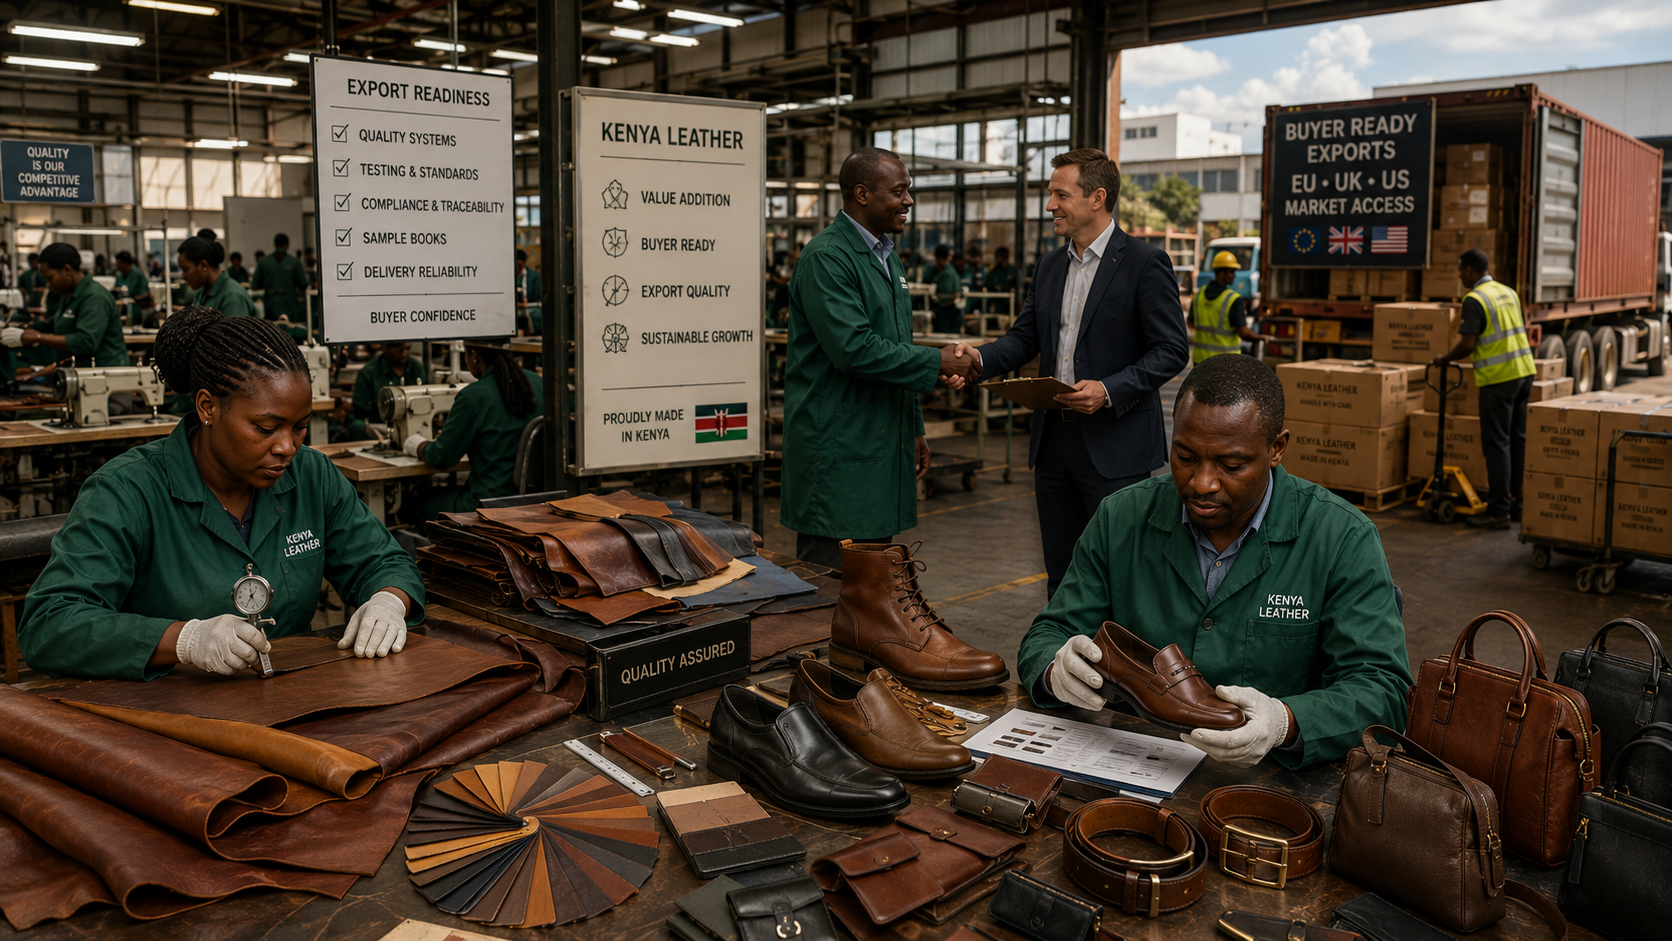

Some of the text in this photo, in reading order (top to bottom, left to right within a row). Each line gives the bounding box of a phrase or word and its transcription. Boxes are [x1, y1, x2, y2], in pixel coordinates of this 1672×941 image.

[348, 78, 490, 106] EXPORT READINESS
[1286, 113, 1417, 141] BUYER READY
[359, 128, 456, 146] QUALITY SYSTEMS
[602, 122, 743, 150] KENYA LEATHER
[27, 146, 69, 159] QUALITY
[1307, 140, 1396, 164] EXPORTS
[33, 160, 65, 172] IS OUR
[360, 163, 479, 180] TESTING & STANDARDS
[18, 172, 80, 185] COMPETITIVE
[1292, 173, 1316, 193] EU
[1335, 171, 1362, 192] UK
[1382, 169, 1410, 190] US
[20, 186, 78, 198] ADVANTAGE
[641, 190, 730, 206] VALUE ADDITION
[362, 198, 504, 213] COMPLIANCE & TRACEABILITY
[1285, 196, 1414, 216] MARKET ACCESS
[363, 232, 447, 245] SAMPLE BOOKS
[642, 238, 716, 251] BUYER READY
[364, 266, 478, 278] DELIVERY RELIABILITY
[642, 285, 730, 298] EXPORT QUALITY
[371, 310, 476, 324] BUYER CONFIDENCE
[642, 330, 753, 345] SUSTAINABLE GROWTH
[604, 409, 684, 425] PROUDLY MADE
[622, 428, 670, 442] IN KENYA
[286, 530, 313, 544] KENYA
[284, 538, 320, 557] LEATHER
[1268, 594, 1304, 606] KENYA
[1259, 606, 1309, 619] LEATHER
[621, 640, 735, 684] QUALITY ASSURED
